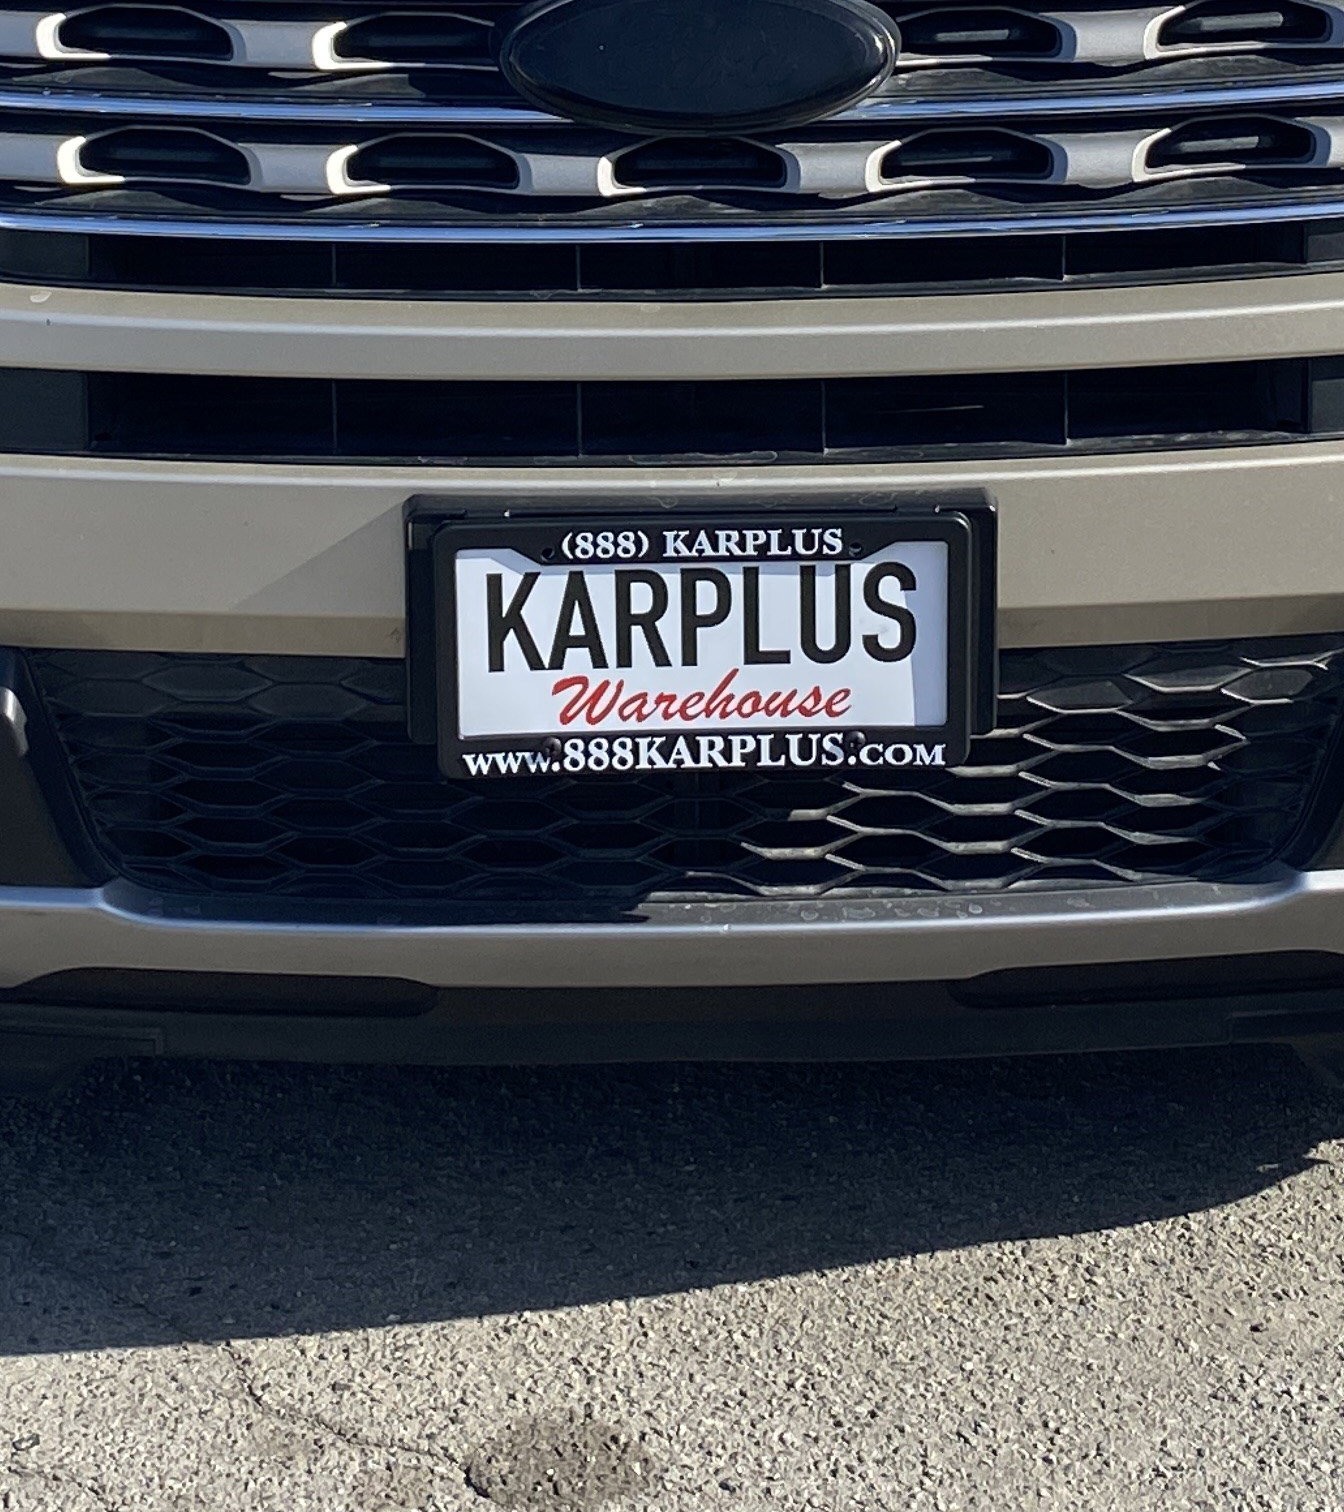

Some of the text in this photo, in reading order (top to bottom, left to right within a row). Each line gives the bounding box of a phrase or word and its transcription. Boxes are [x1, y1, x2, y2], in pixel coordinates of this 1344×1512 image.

[561, 528, 844, 560] (888) KARPLUS
[485, 561, 918, 674] KARPLUS
[551, 668, 853, 727] Warehouse
